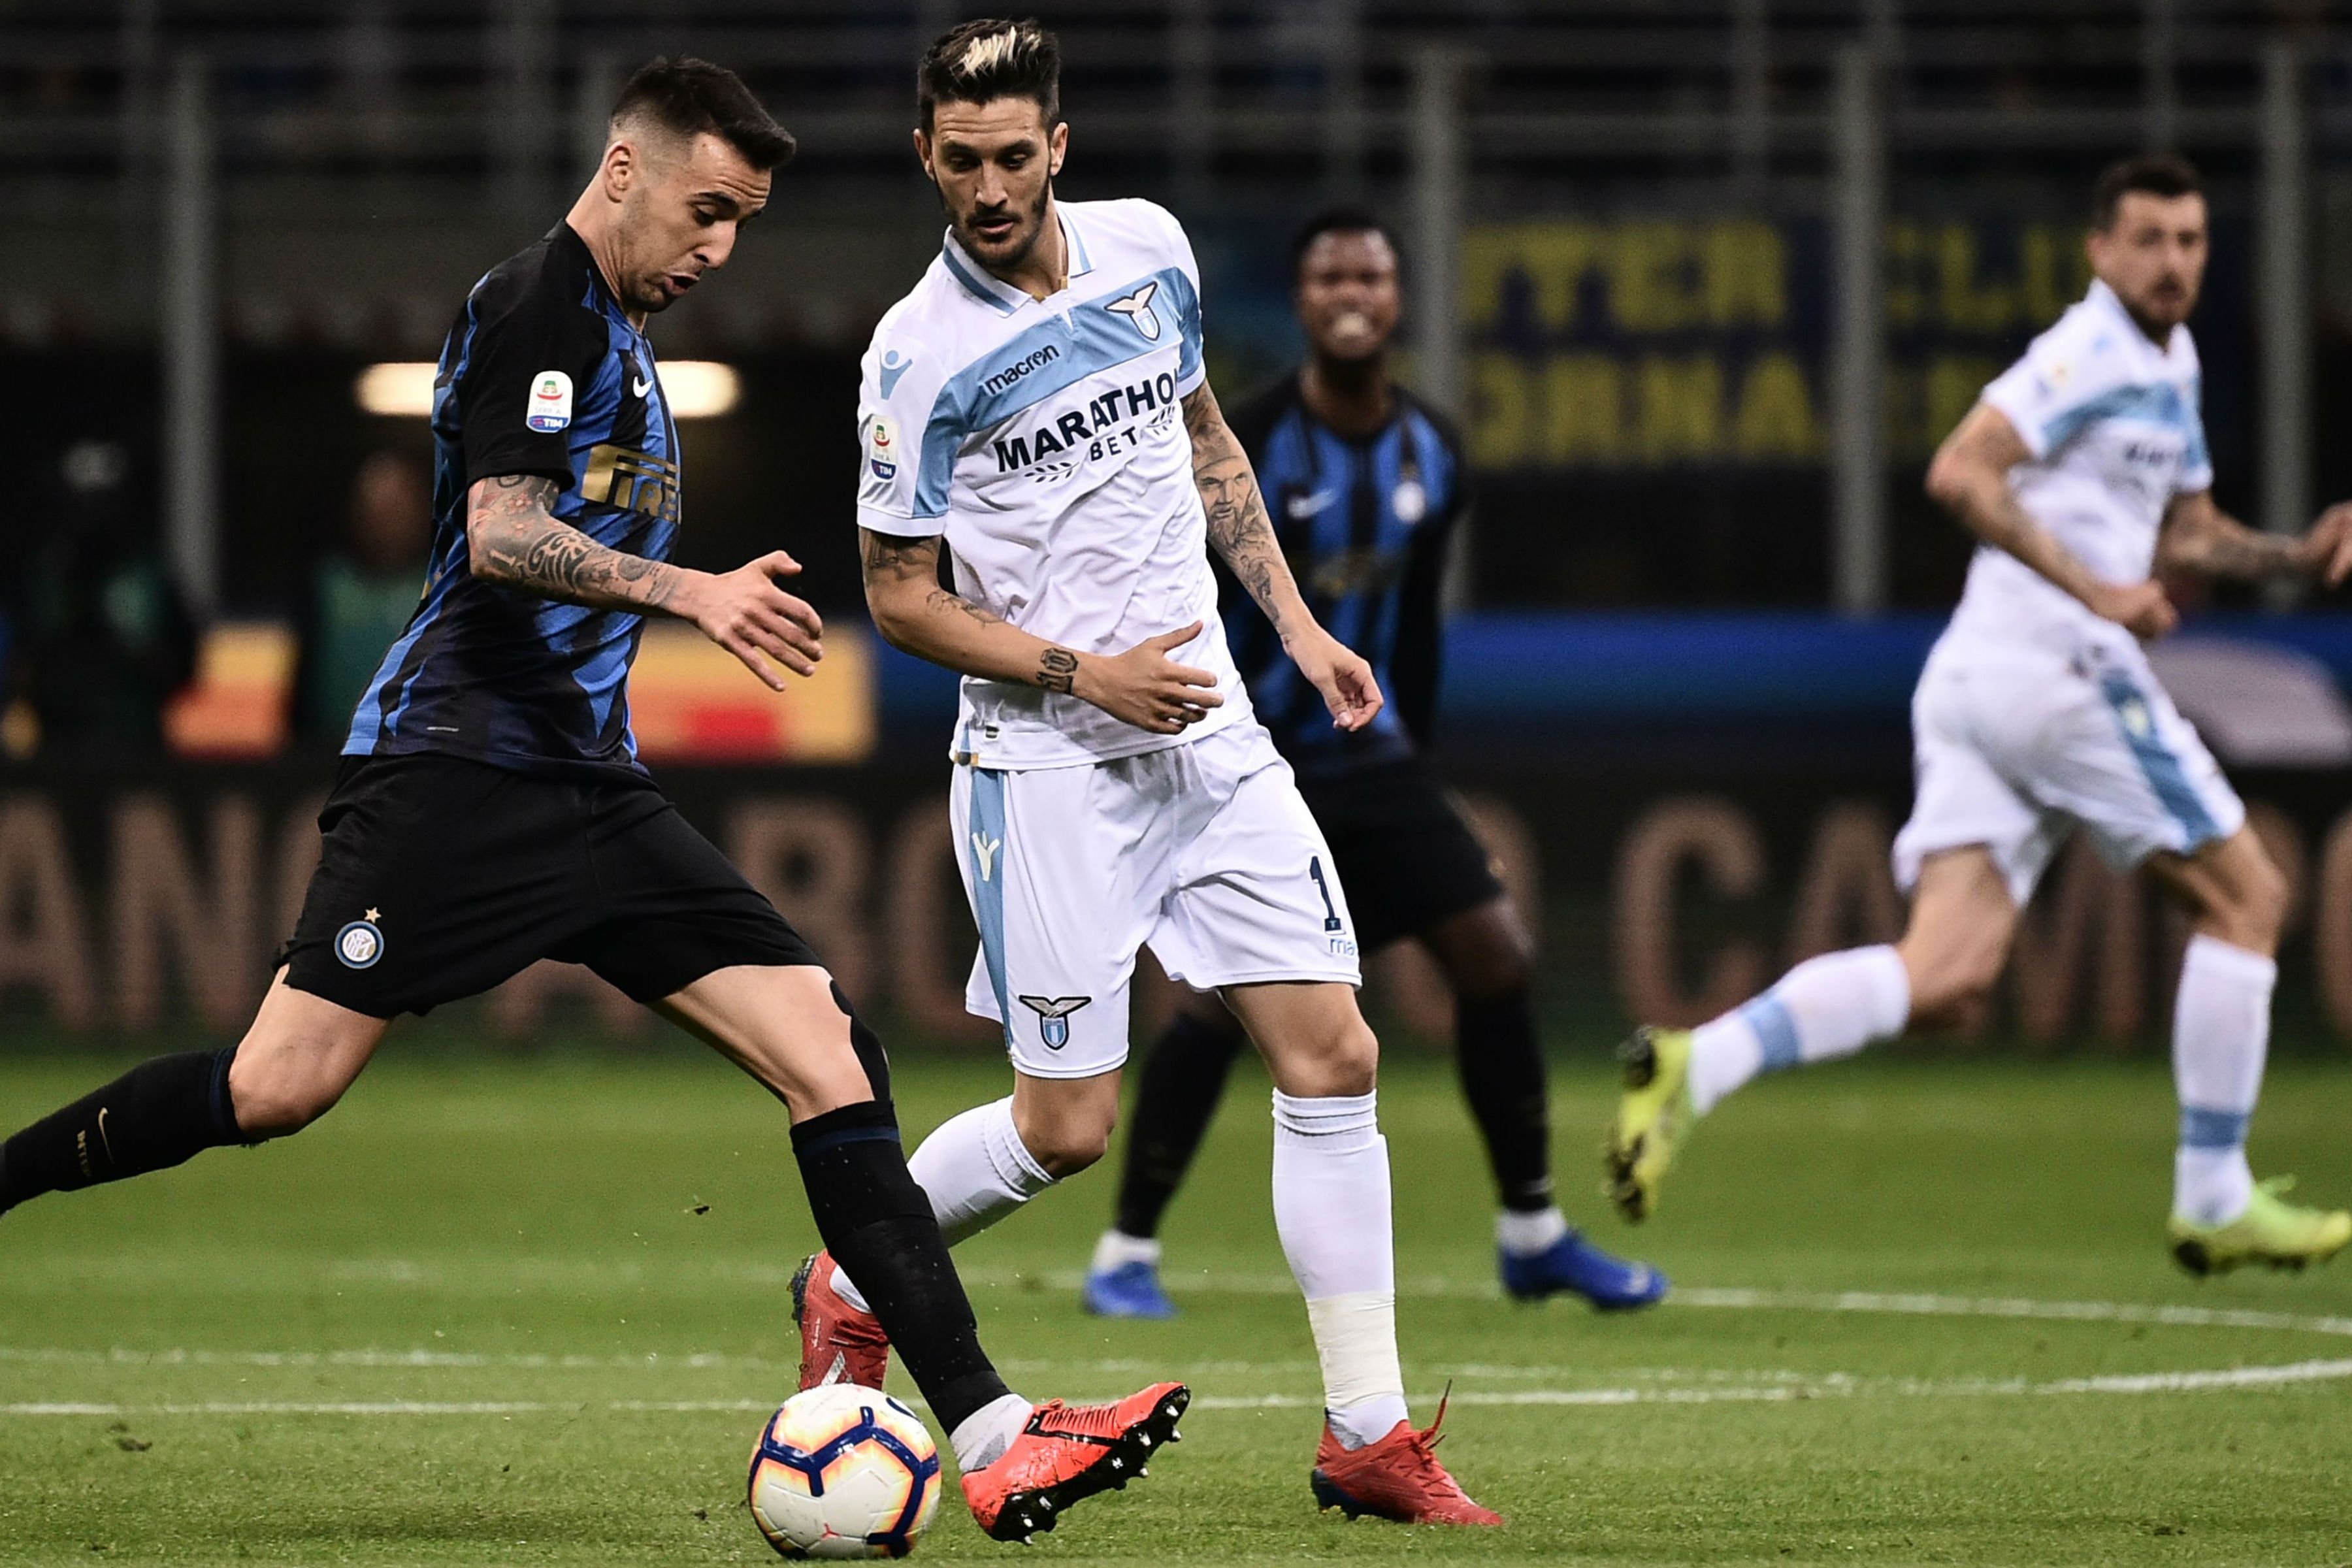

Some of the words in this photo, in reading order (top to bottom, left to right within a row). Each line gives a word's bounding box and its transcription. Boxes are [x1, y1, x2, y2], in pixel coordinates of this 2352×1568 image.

[985, 345, 1060, 395] macron
[544, 418, 564, 429] TIM
[994, 368, 1178, 472] MARATHO
[1089, 426, 1137, 461] BET
